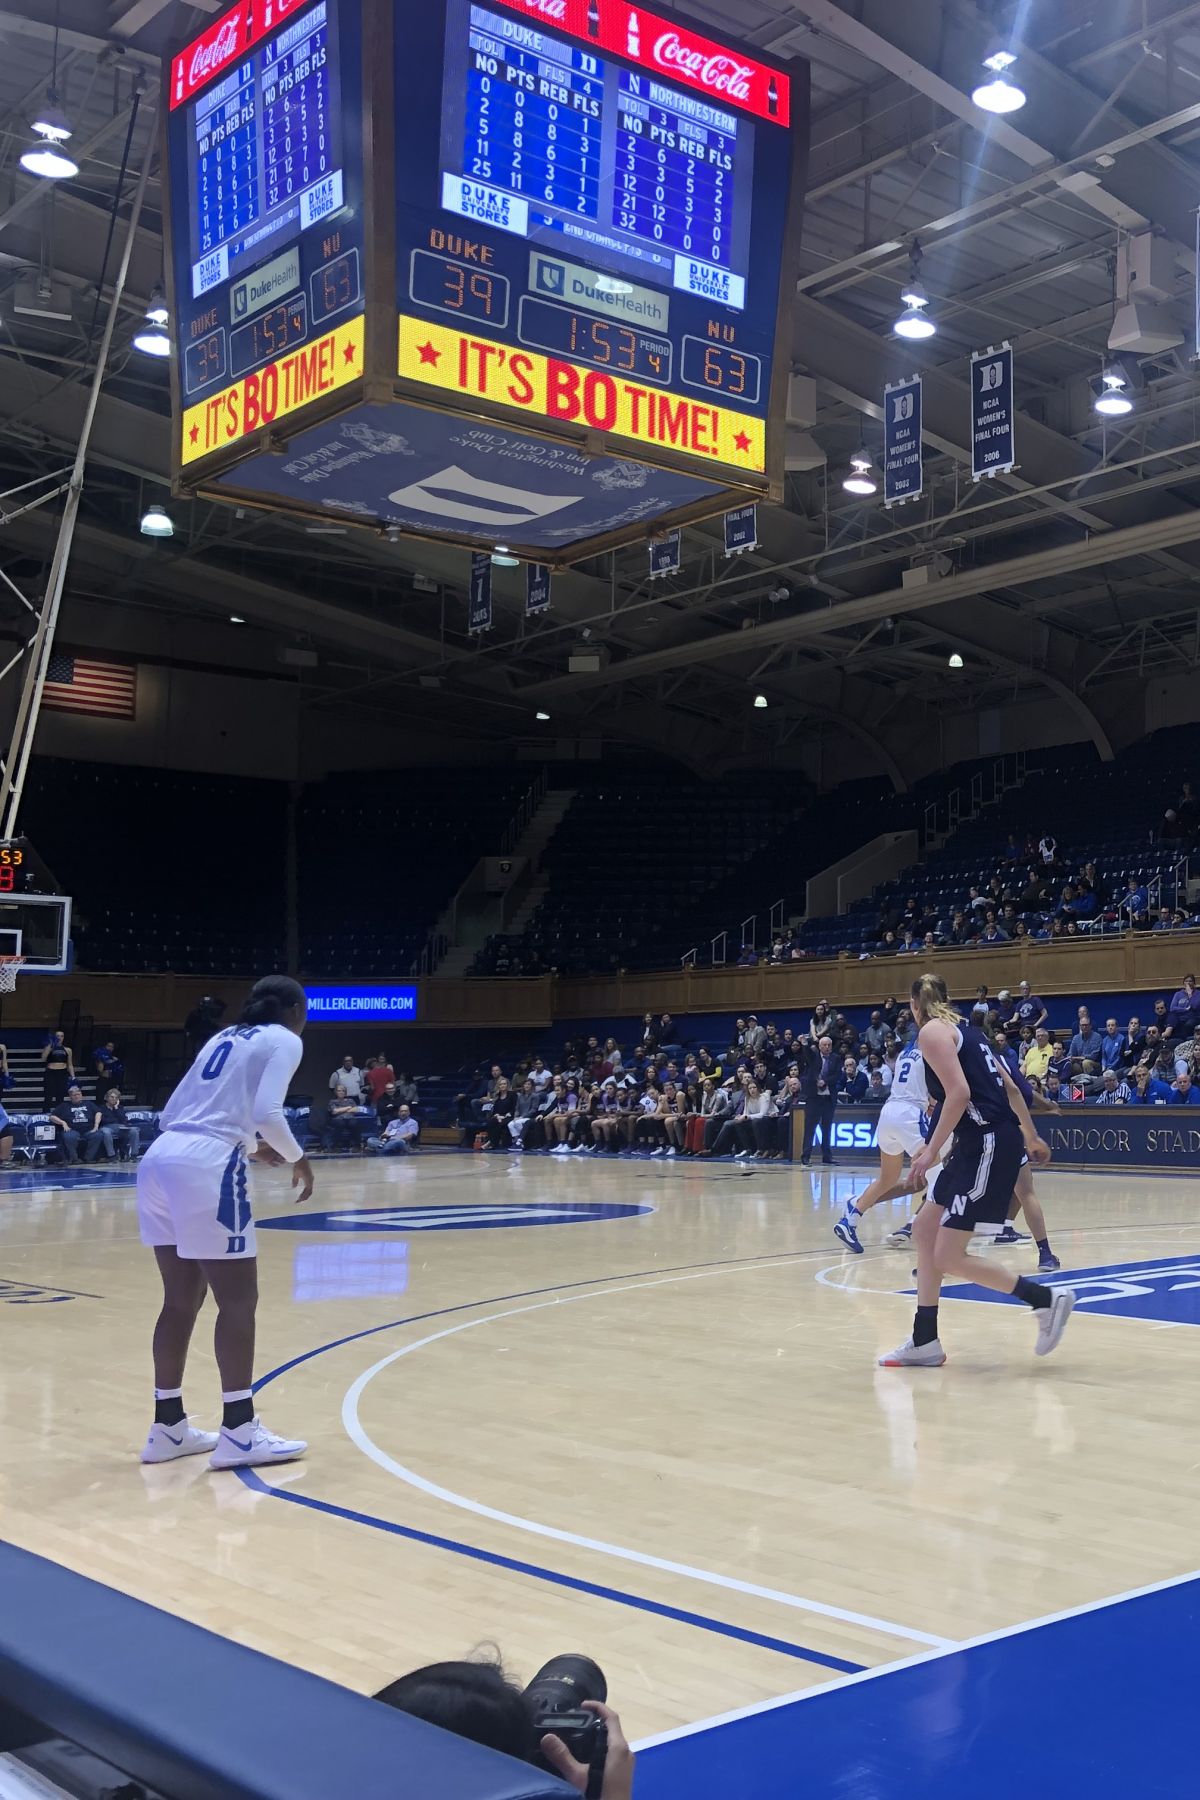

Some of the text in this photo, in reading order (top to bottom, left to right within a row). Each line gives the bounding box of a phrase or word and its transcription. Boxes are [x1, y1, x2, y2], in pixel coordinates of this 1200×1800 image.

[189, 10, 241, 86] Coca-Cola
[503, 20, 543, 50] DUKE
[476, 53, 600, 116] NO PTS REB FLS
[653, 32, 755, 101] Coca-Cola
[481, 77, 588, 133] 0 0 0 1
[583, 82, 591, 94] 4
[650, 81, 736, 133] NORTHWESTERN
[480, 98, 588, 152] 2 8 8 3
[624, 114, 732, 170] NO PTS REB FLS
[480, 118, 586, 172] 5 8 6 1
[628, 136, 723, 186] 2 6 2 2
[477, 138, 585, 192] 11 2 3 1
[627, 155, 722, 204] 3 3 5 2
[308, 180, 332, 203] DUKE
[462, 183, 510, 210] DUKE
[473, 158, 585, 212] 25 11 6 2
[624, 174, 721, 222] 12 0 3 3
[309, 199, 334, 220] STORES
[462, 201, 509, 225] STORES
[622, 193, 720, 241] 21 12 7 0
[430, 228, 495, 266] DUKE
[620, 212, 720, 260] 32 0 0 0
[250, 263, 297, 301] DukeHealth
[444, 265, 493, 315] 39
[690, 263, 730, 286] DUKE
[690, 280, 729, 300] STORES
[572, 280, 662, 319] DukeHealth
[191, 308, 217, 337] DUKE
[708, 320, 735, 342] NU
[570, 317, 636, 370] 1:53
[640, 339, 669, 356] PERIOD
[648, 355, 660, 373] 4
[704, 348, 745, 392] 63
[205, 336, 335, 448] IT'S BO TIME!
[458, 338, 719, 455] IT'S BO TIME!
[983, 398, 999, 410] NCAA
[896, 428, 910, 440] NCAA
[975, 425, 1010, 442] FINAL FOUR
[977, 410, 1006, 426] WOMEN'S
[887, 454, 919, 470] FINAL FOUR
[890, 441, 916, 455] WOMEN'S
[201, 1041, 233, 1080] 0
[899, 1063, 911, 1082] 2
[1050, 1128, 1130, 1152] INDOOR
[951, 1194, 968, 1216] N
